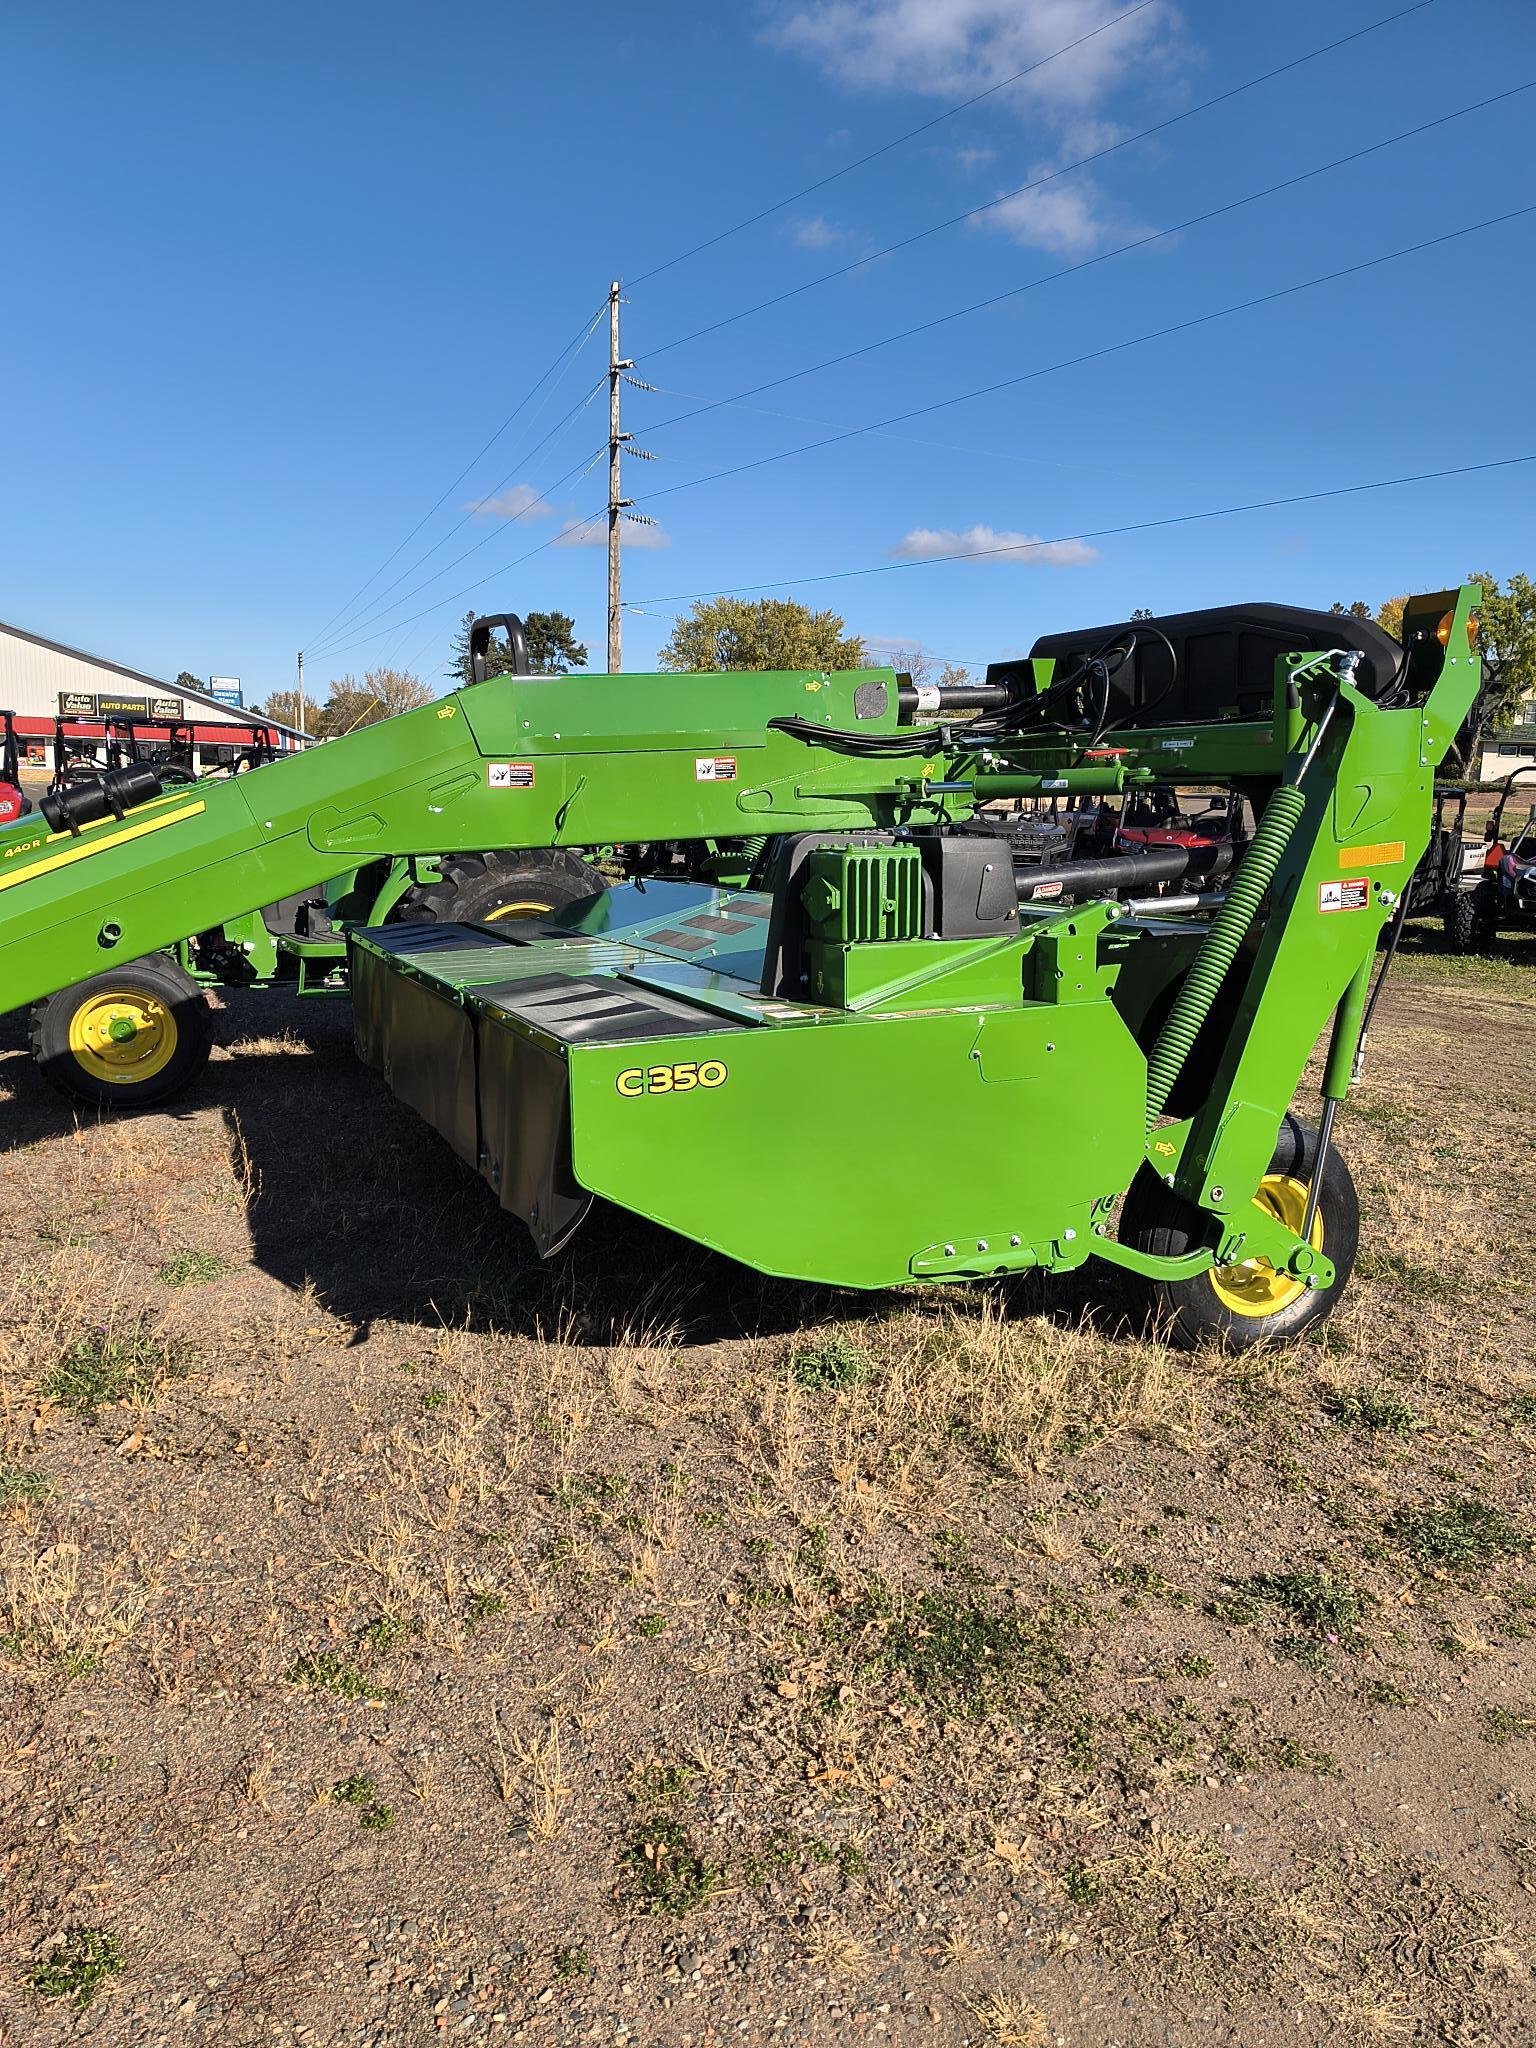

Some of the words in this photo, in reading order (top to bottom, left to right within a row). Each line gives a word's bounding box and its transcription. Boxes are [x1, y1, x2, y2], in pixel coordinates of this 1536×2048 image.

[67, 694, 90, 703] Auto
[65, 701, 92, 710] Value
[100, 702, 120, 710] AUTO
[121, 703, 146, 711] PARTS
[155, 700, 177, 708] Auto
[153, 705, 179, 715] Value
[4, 843, 31, 858] 440
